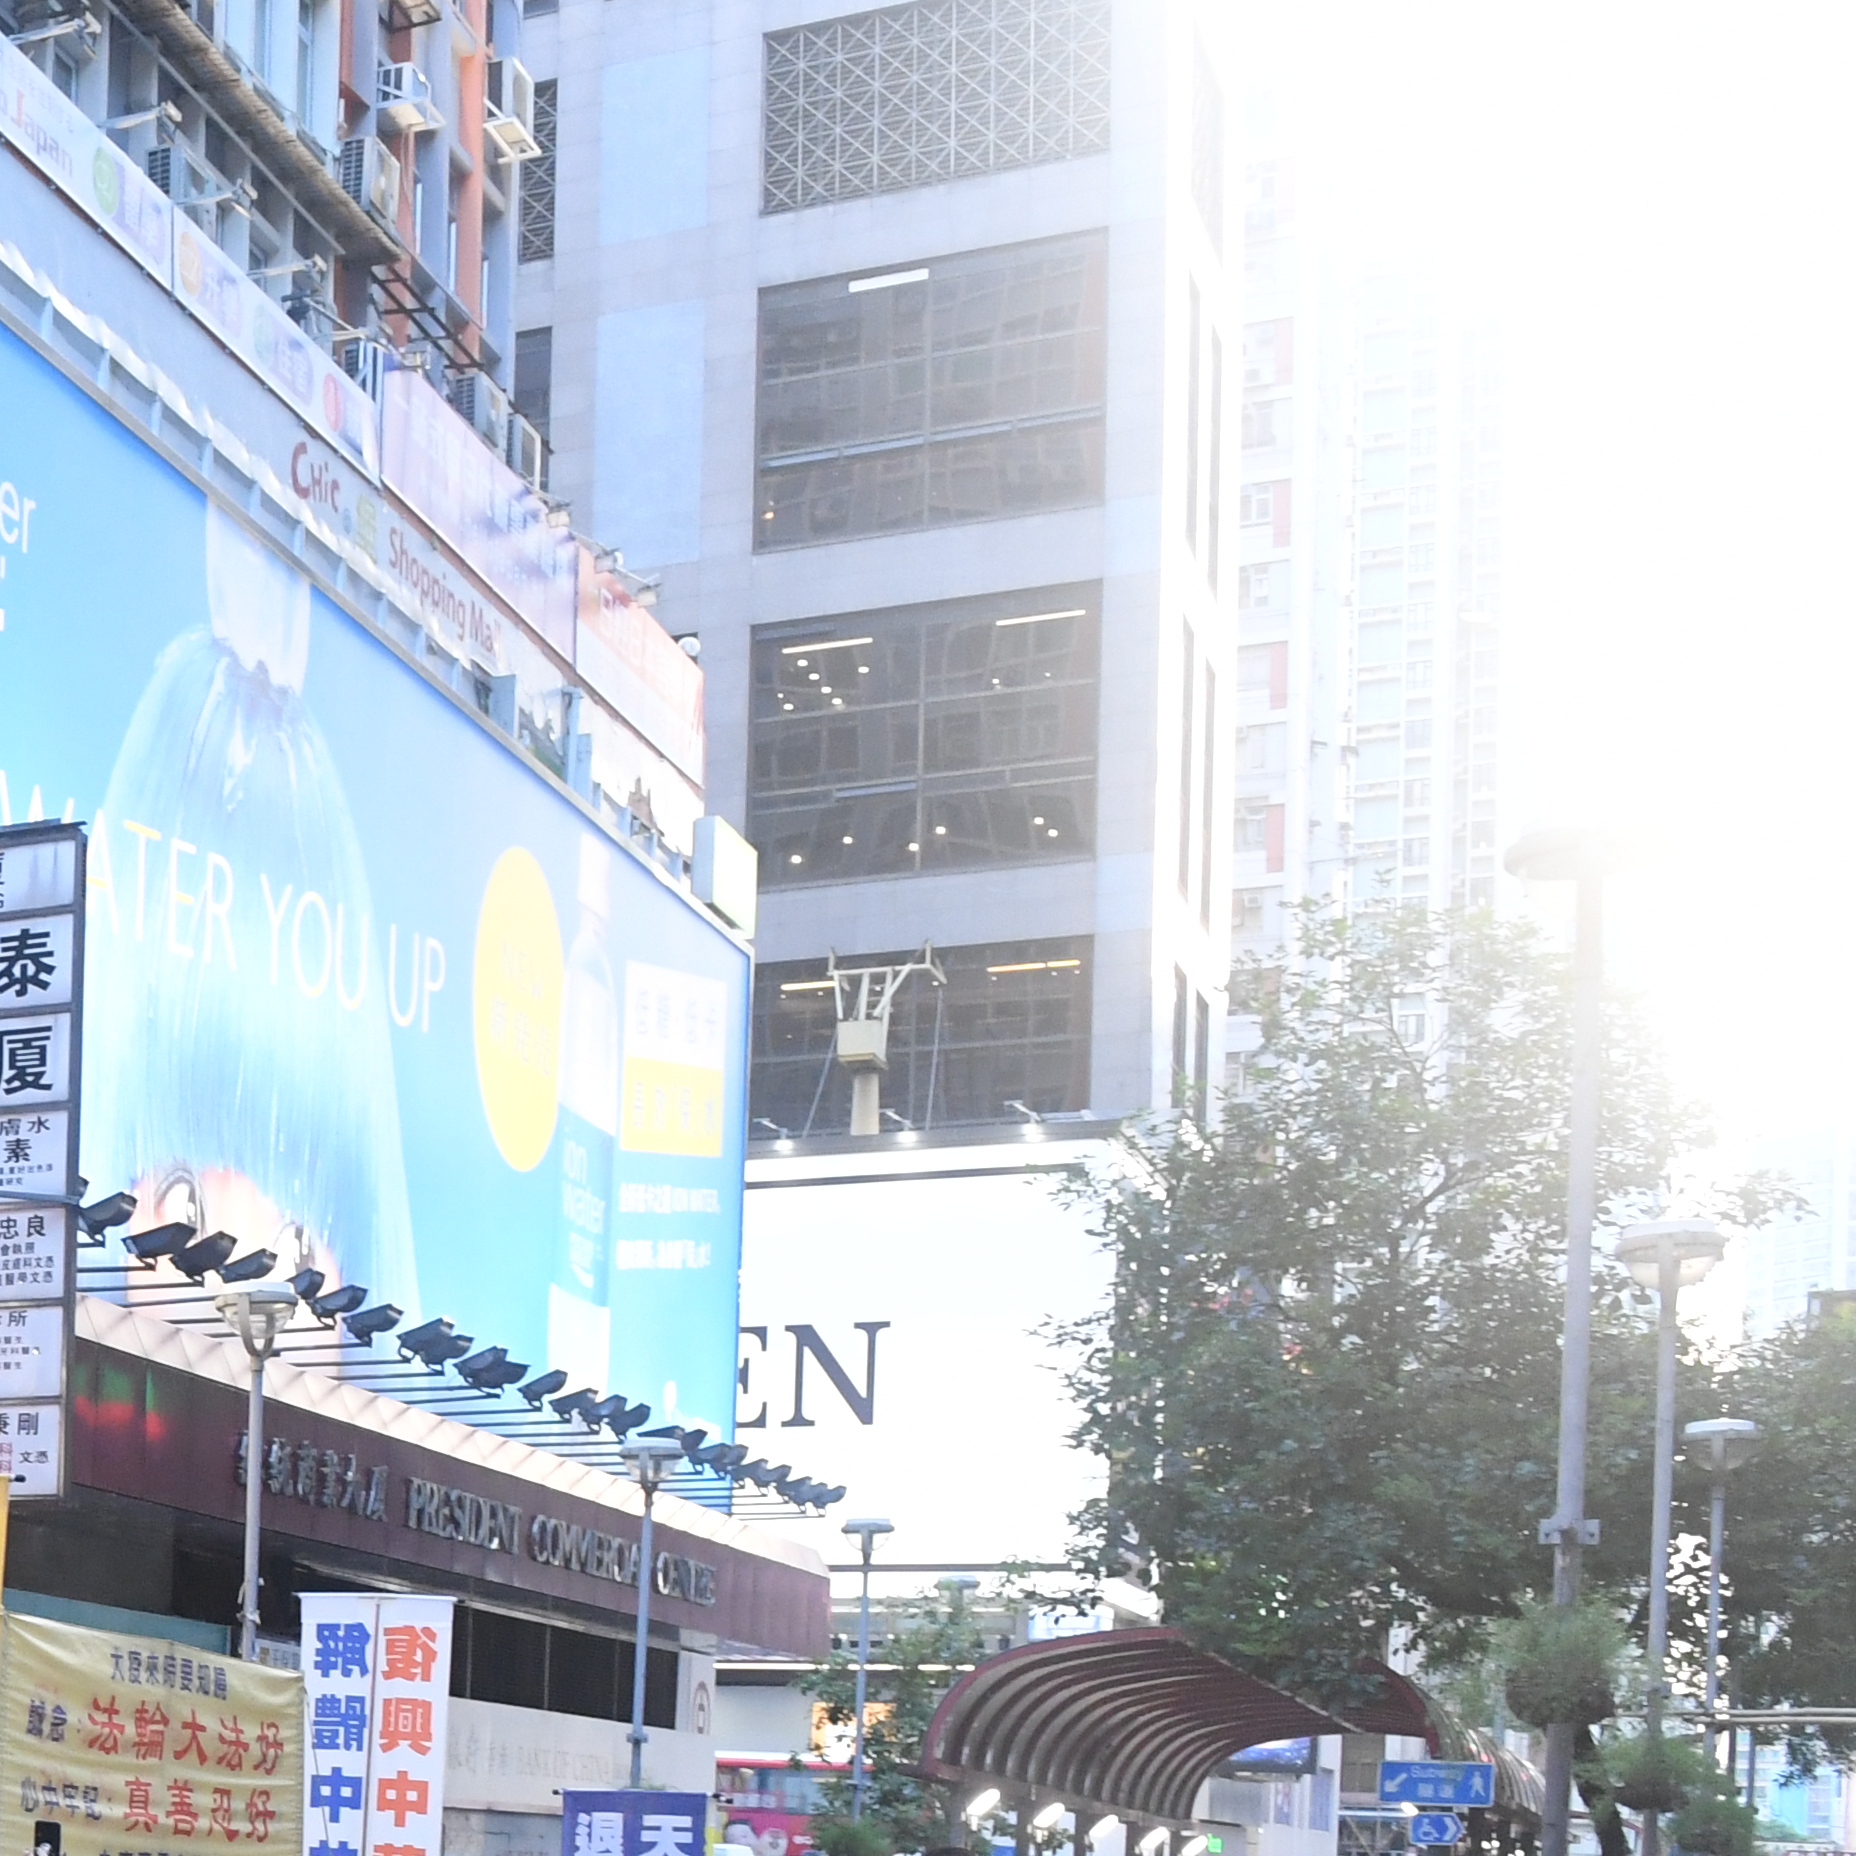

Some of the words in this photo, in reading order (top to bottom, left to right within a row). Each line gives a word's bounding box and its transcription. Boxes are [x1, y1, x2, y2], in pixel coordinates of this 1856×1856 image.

[389, 525, 468, 643] Shopping
[260, 872, 370, 1012] YOU
[388, 922, 447, 1032] UP
[408, 1476, 523, 1556] PRESIDENT
[530, 1512, 656, 1589] COMMERCIA
[656, 1551, 717, 1606] CENTRE
